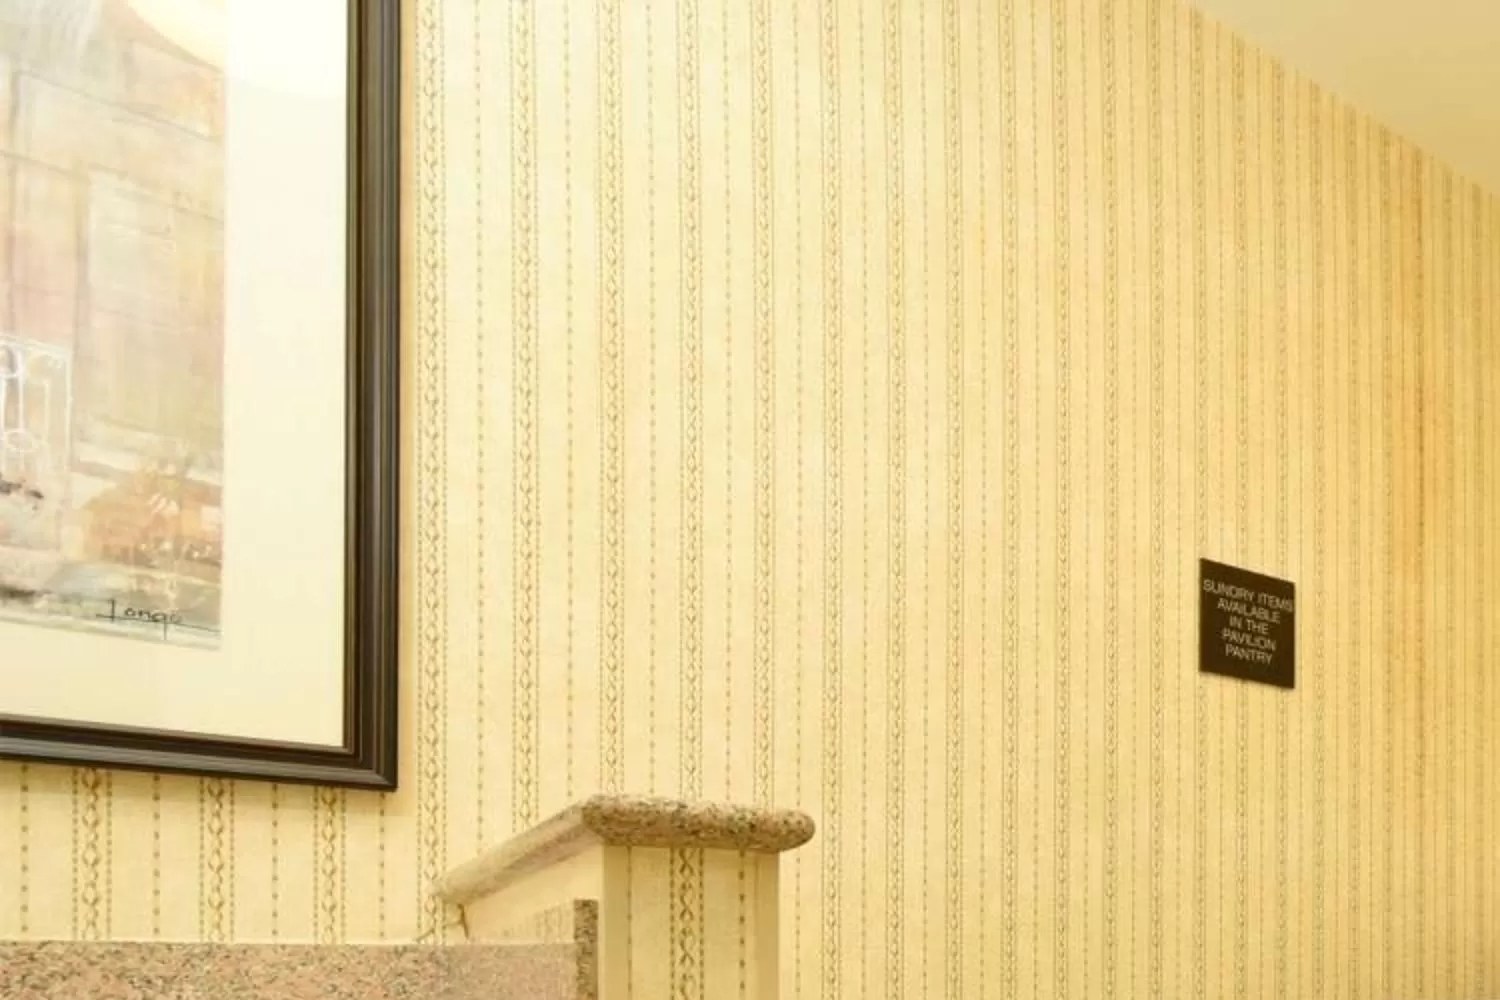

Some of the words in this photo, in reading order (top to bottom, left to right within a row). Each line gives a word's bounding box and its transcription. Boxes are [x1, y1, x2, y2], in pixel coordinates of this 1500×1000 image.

[1203, 579, 1254, 601] SUNDRY
[1218, 597, 1280, 624] AVAILABLE
[1230, 615, 1242, 629] IN
[1247, 619, 1268, 635] THE
[1222, 627, 1276, 651] PAVILION
[1225, 643, 1272, 664] PANTRY
